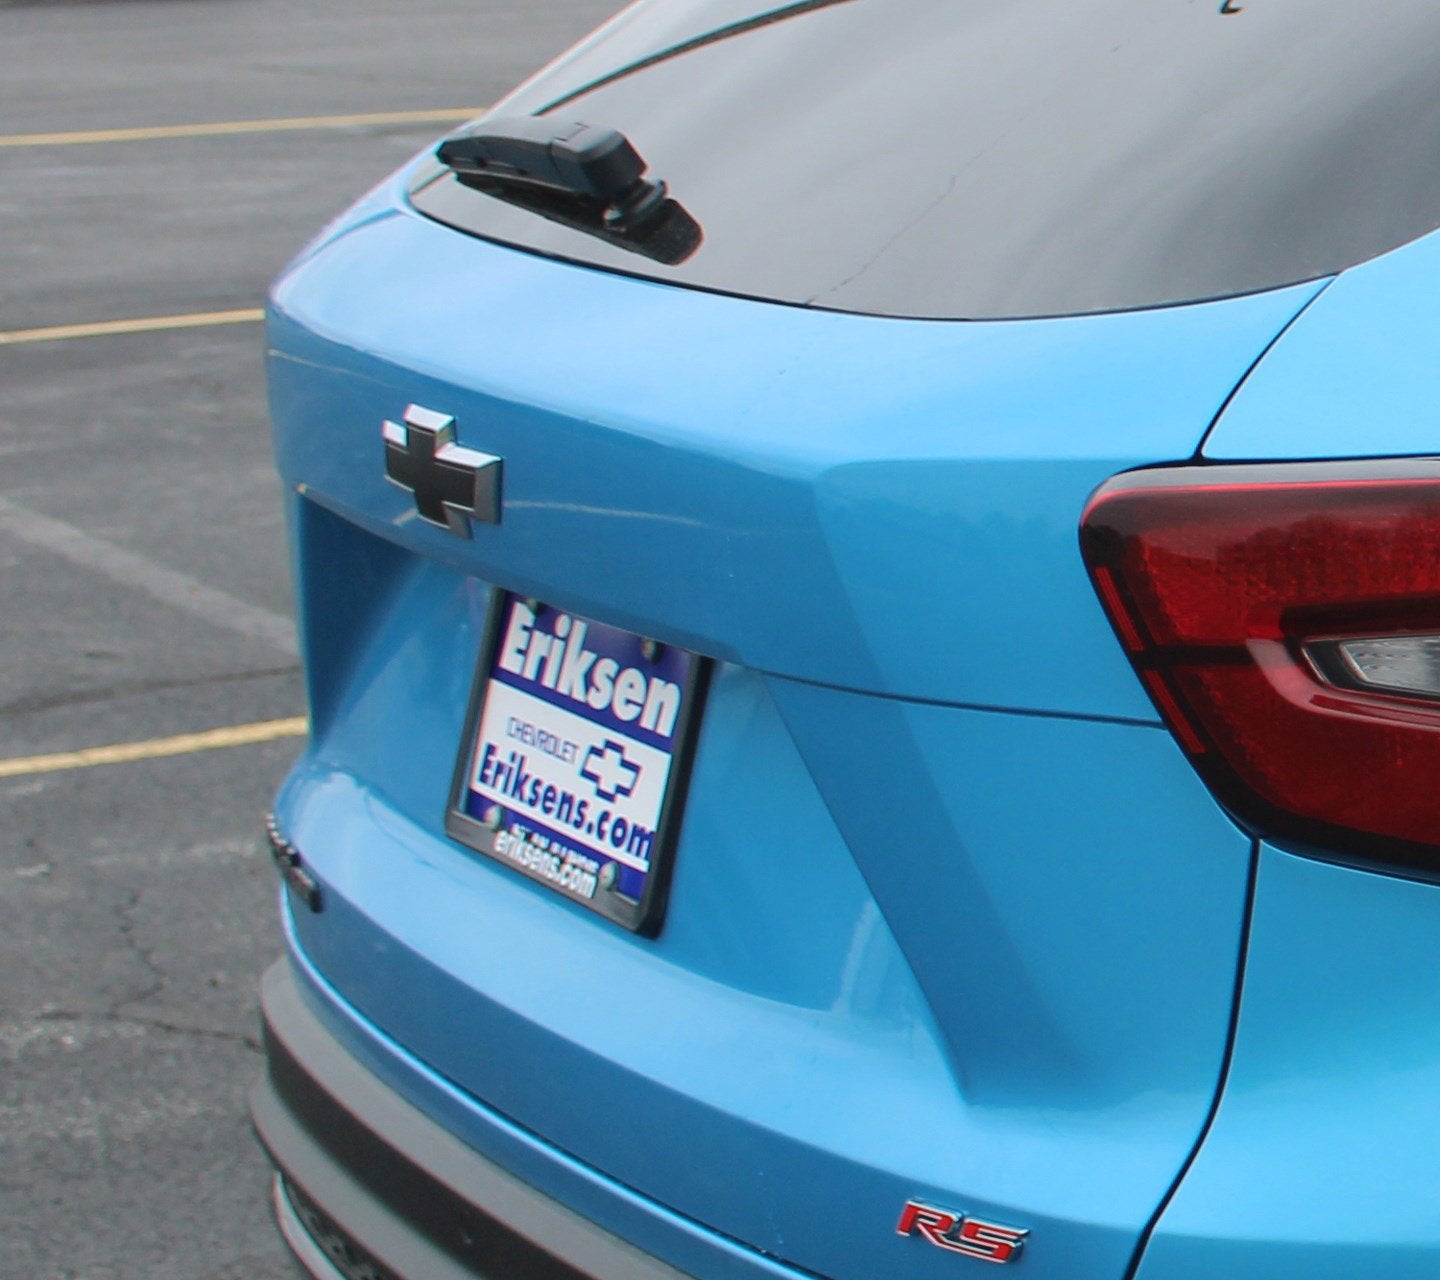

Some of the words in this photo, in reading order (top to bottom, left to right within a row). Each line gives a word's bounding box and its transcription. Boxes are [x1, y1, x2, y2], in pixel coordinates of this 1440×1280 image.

[499, 601, 682, 738] Eriksen
[506, 716, 580, 765] CHEVROLET
[477, 743, 653, 859] Eriksens.com
[897, 1197, 1030, 1263] RS
